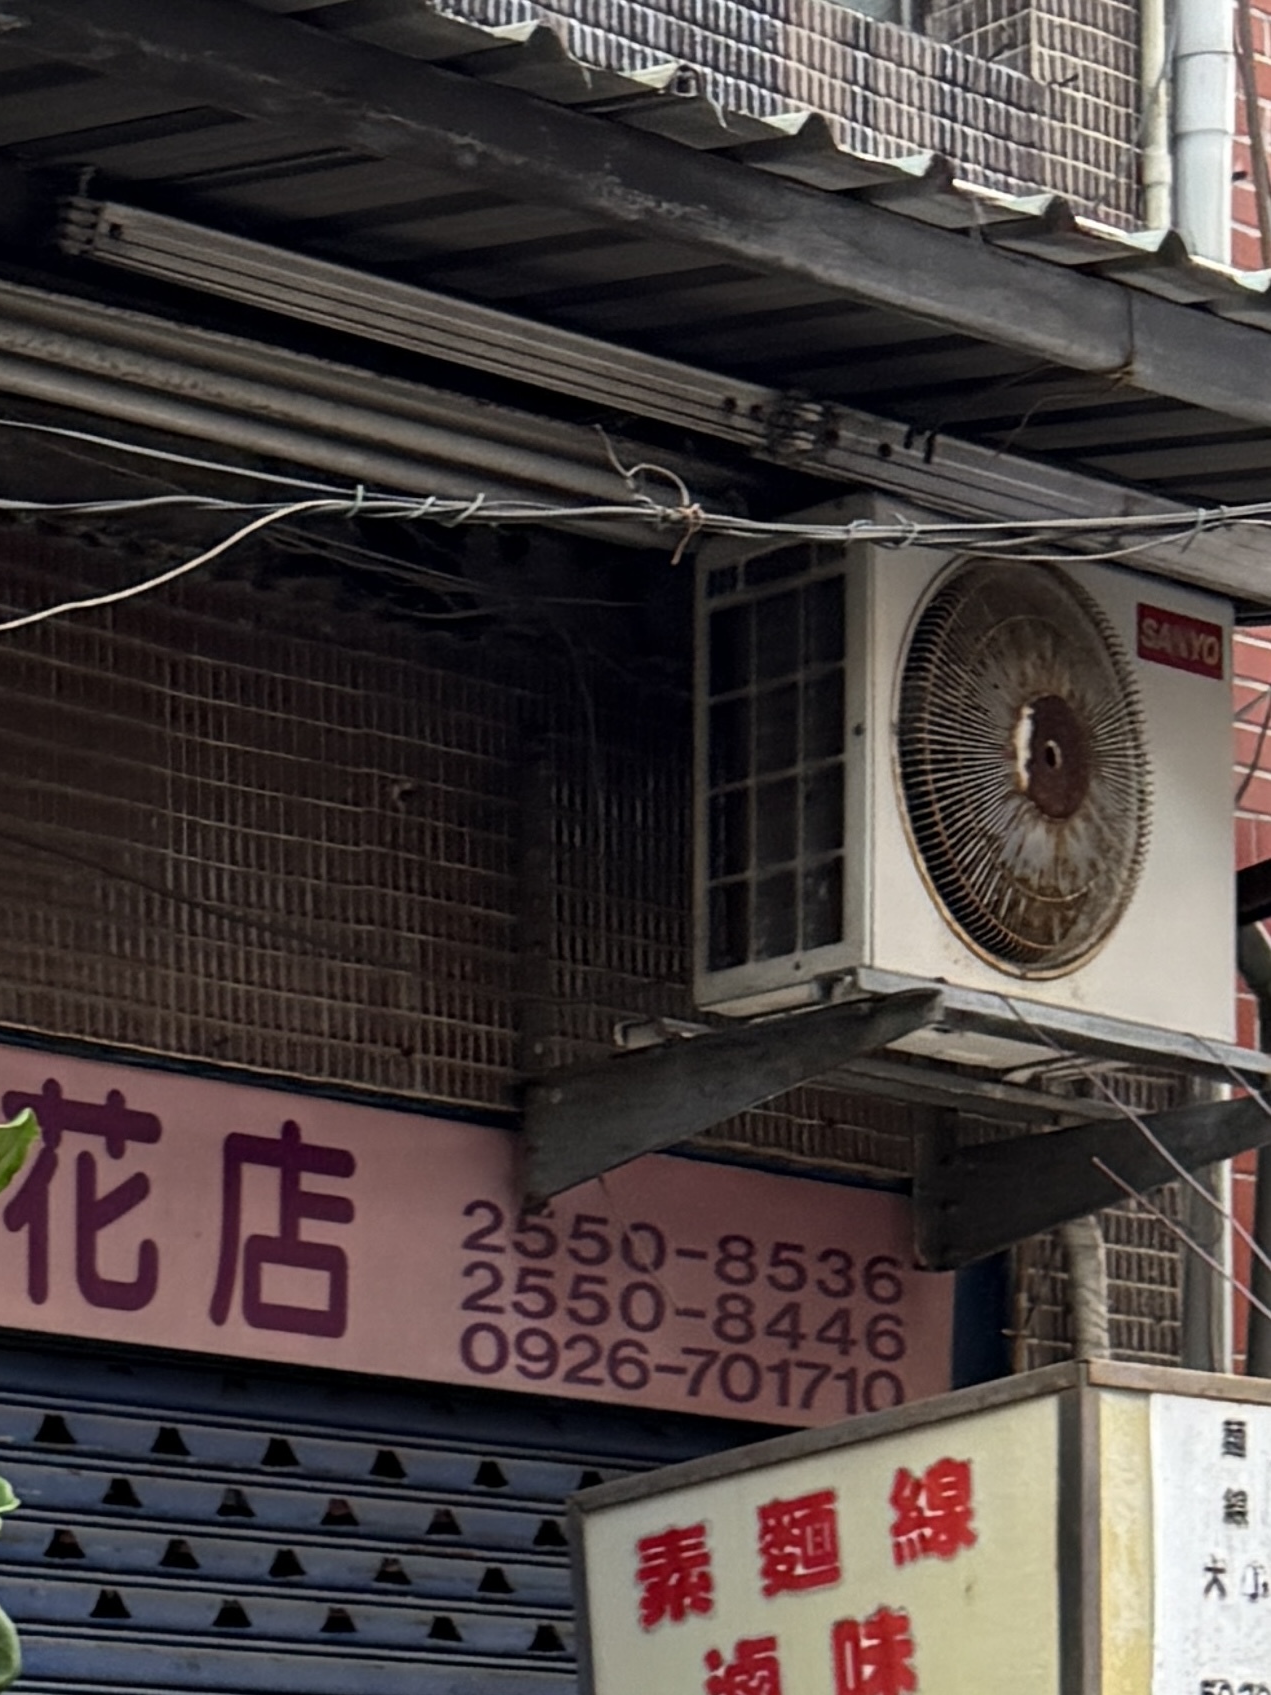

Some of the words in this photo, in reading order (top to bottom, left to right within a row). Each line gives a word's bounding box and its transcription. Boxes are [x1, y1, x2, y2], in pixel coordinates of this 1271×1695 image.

[1140, 618, 1219, 665] SANYO
[462, 1200, 905, 1305] 2550-8536
[462, 1260, 905, 1362] 2550-8446
[460, 1321, 905, 1414] 0926-701710
[635, 1456, 980, 1633] 素麵線
